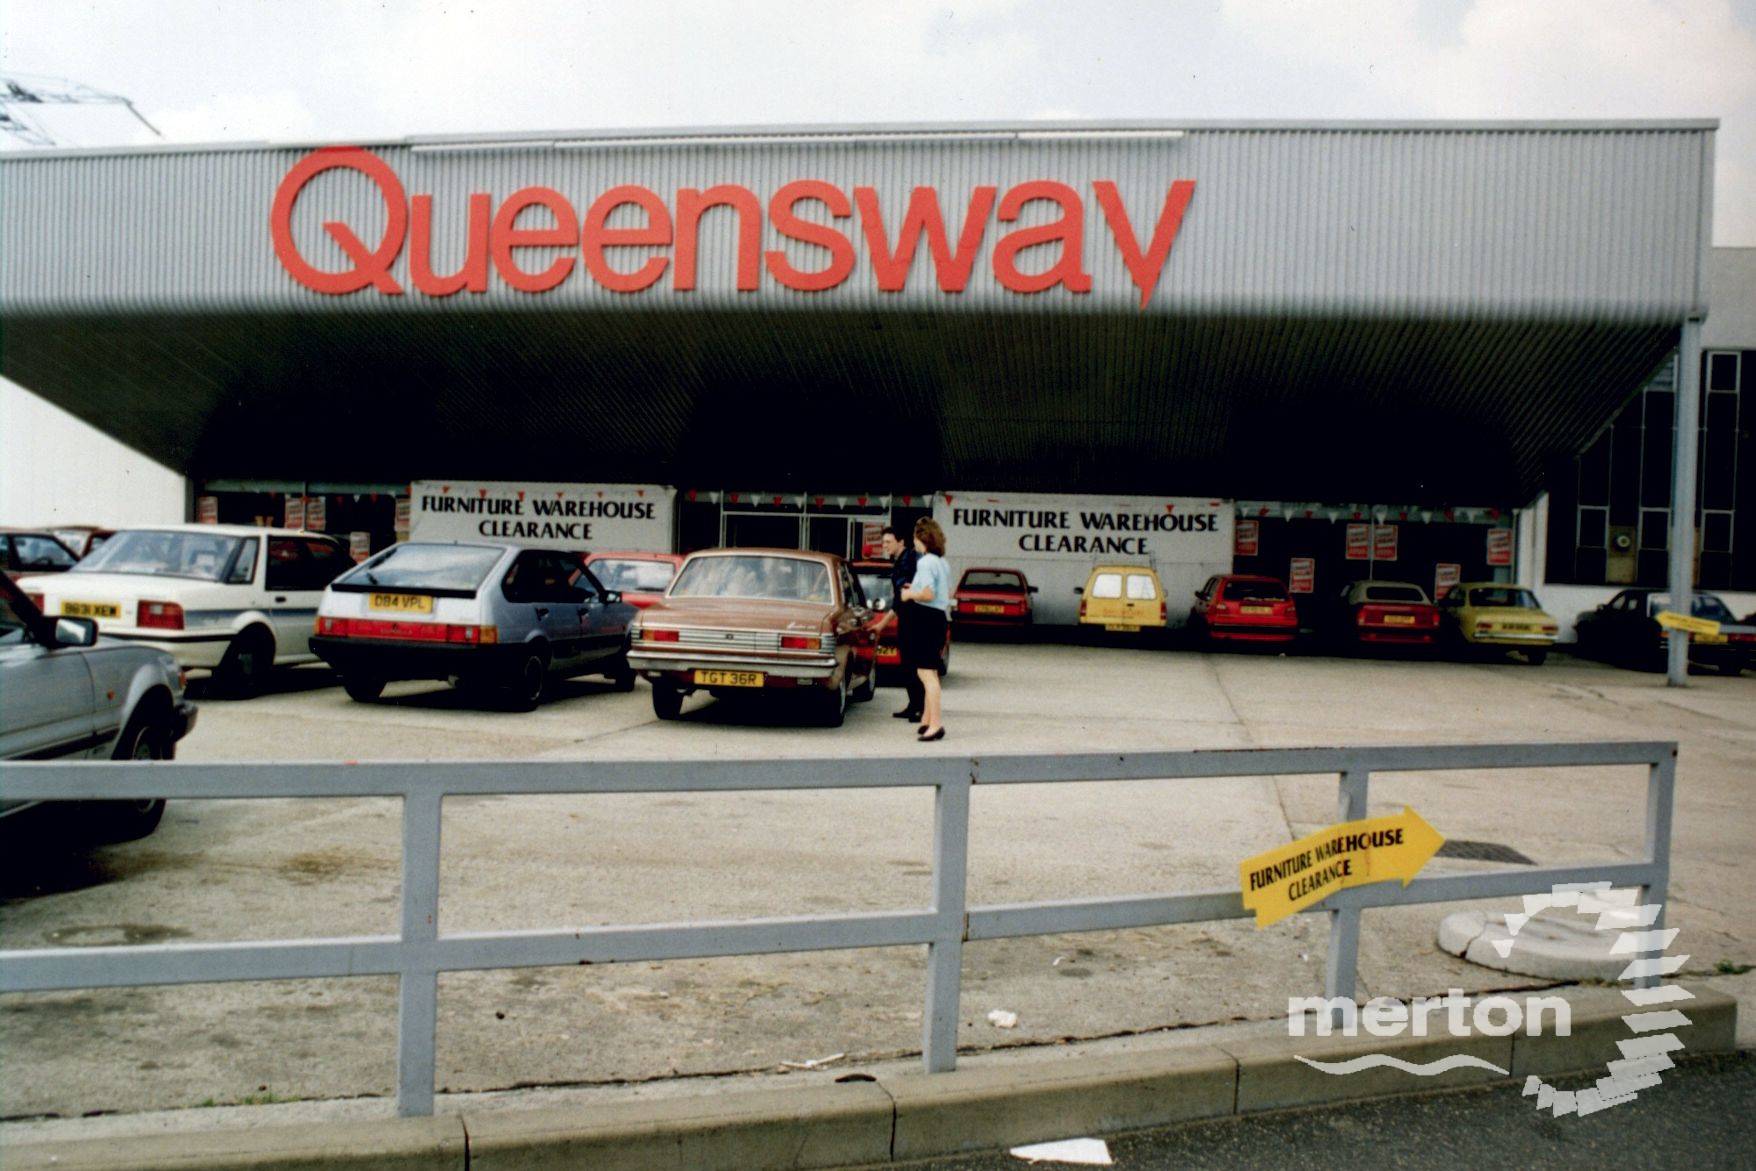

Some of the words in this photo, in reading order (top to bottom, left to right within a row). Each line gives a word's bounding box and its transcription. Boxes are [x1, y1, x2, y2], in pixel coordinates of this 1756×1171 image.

[271, 146, 1196, 311] Queensway
[422, 495, 524, 516] FURNITURE
[533, 500, 656, 520] WAREHOUSE
[479, 520, 593, 540] CLEARANCE
[953, 508, 1070, 529] FURNITURE
[1081, 512, 1219, 532] WAREHOUSE
[1019, 534, 1149, 555] CLEARANCE
[402, 596, 425, 609] VPL
[700, 671, 726, 684] TGT
[730, 672, 756, 685] 36R
[1250, 851, 1312, 891] FURNITURE
[1315, 828, 1404, 863] WAREHOUSE
[1288, 859, 1352, 901] CLEARANCE
